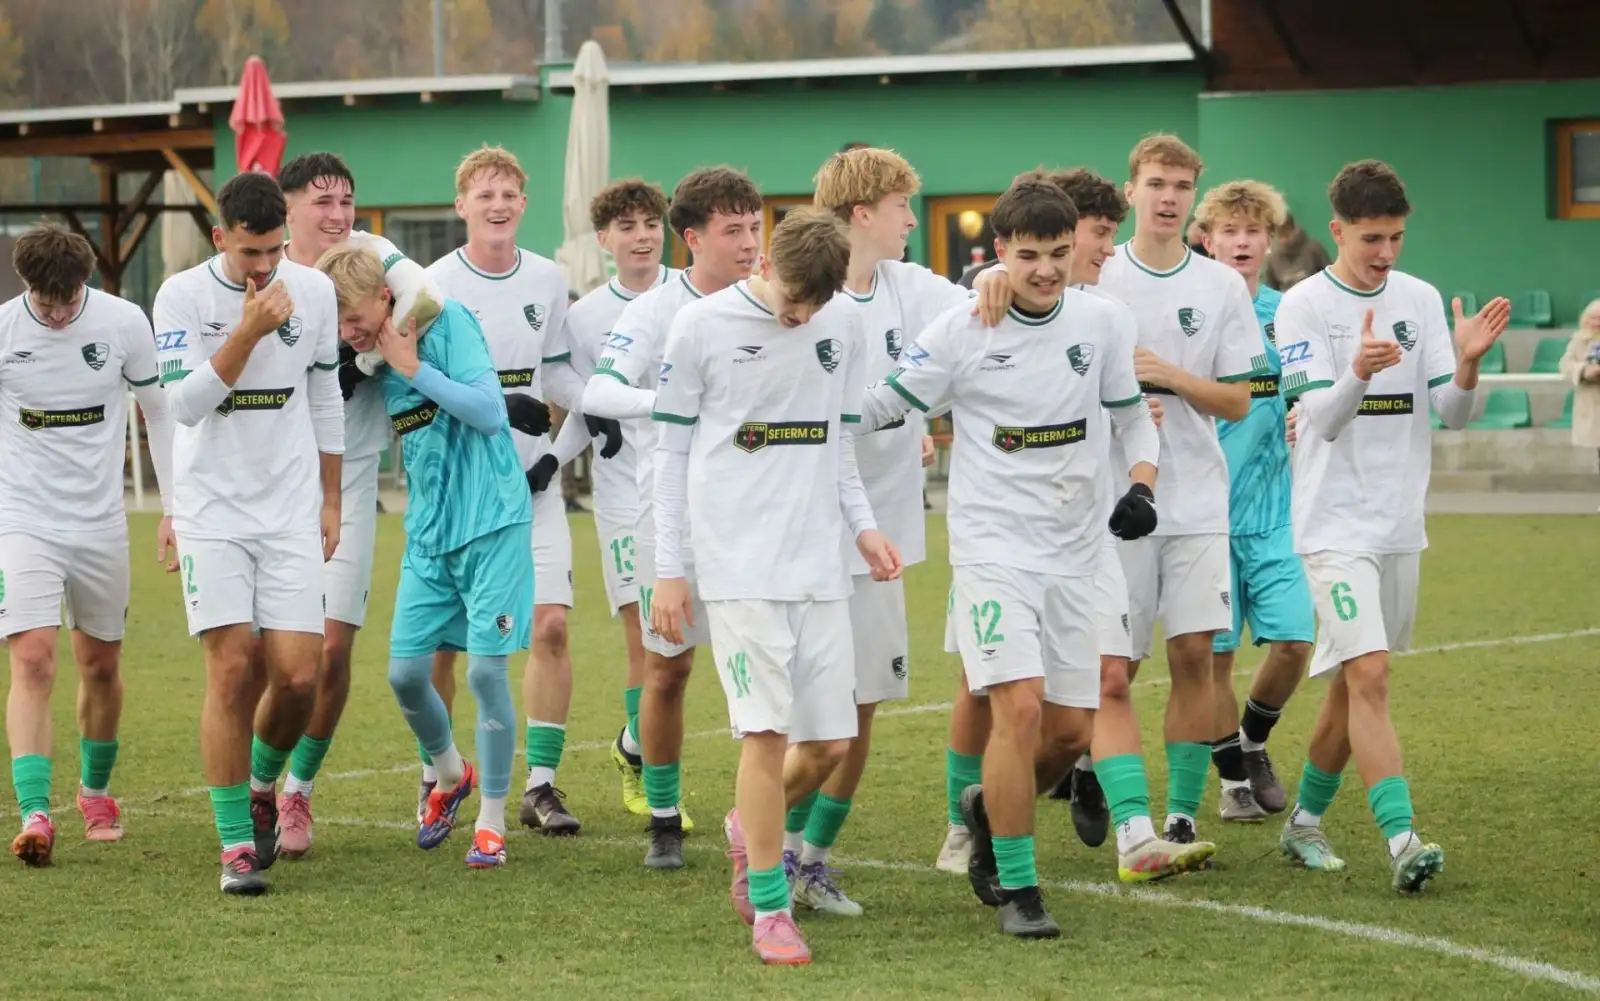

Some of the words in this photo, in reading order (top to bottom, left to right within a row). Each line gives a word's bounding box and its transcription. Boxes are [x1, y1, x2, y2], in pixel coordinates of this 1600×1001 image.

[499, 374, 521, 383] TERM
[235, 394, 274, 405] SETERM
[45, 413, 81, 423] SETERM
[768, 427, 807, 440] SETERM
[809, 427, 825, 439] CB
[1026, 429, 1066, 443] SETERM
[1066, 427, 1077, 438] CB
[182, 554, 198, 594] 2
[1330, 581, 1357, 622] 6
[969, 599, 1005, 647] 12
